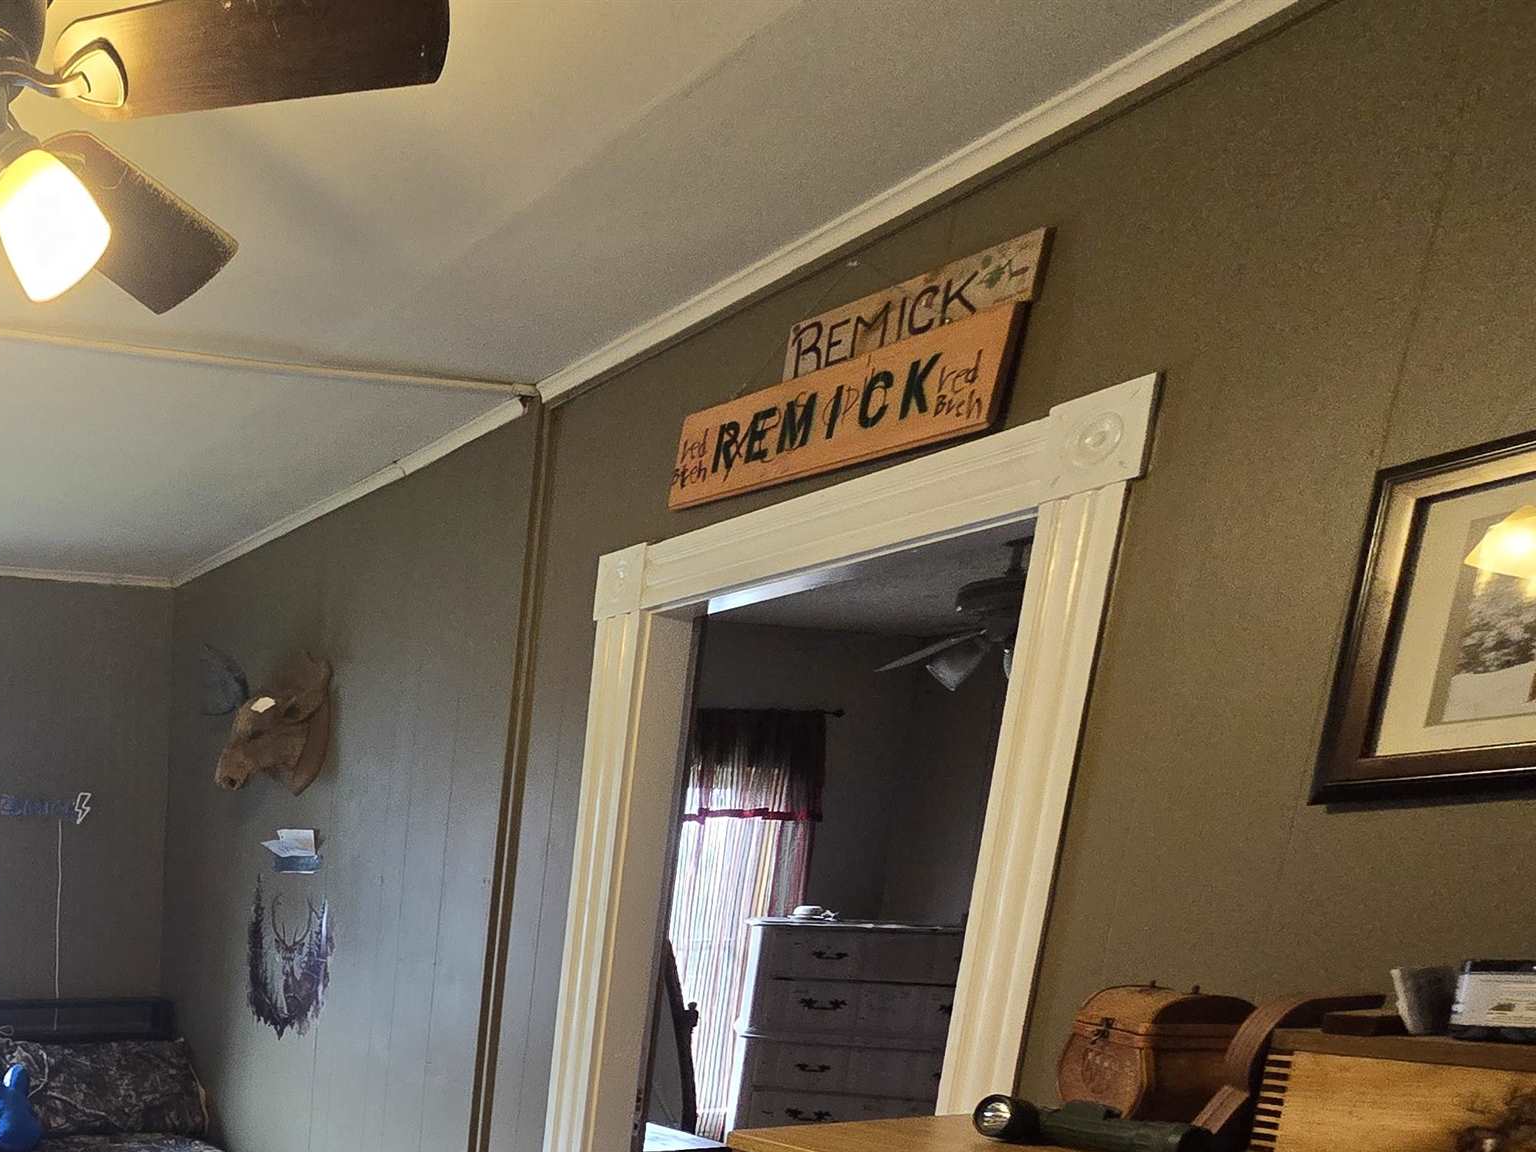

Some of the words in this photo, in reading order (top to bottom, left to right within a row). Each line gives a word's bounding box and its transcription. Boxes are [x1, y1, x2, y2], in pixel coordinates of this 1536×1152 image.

[792, 270, 981, 379] REMICK
[937, 347, 984, 389] red
[711, 351, 943, 474] REMICK
